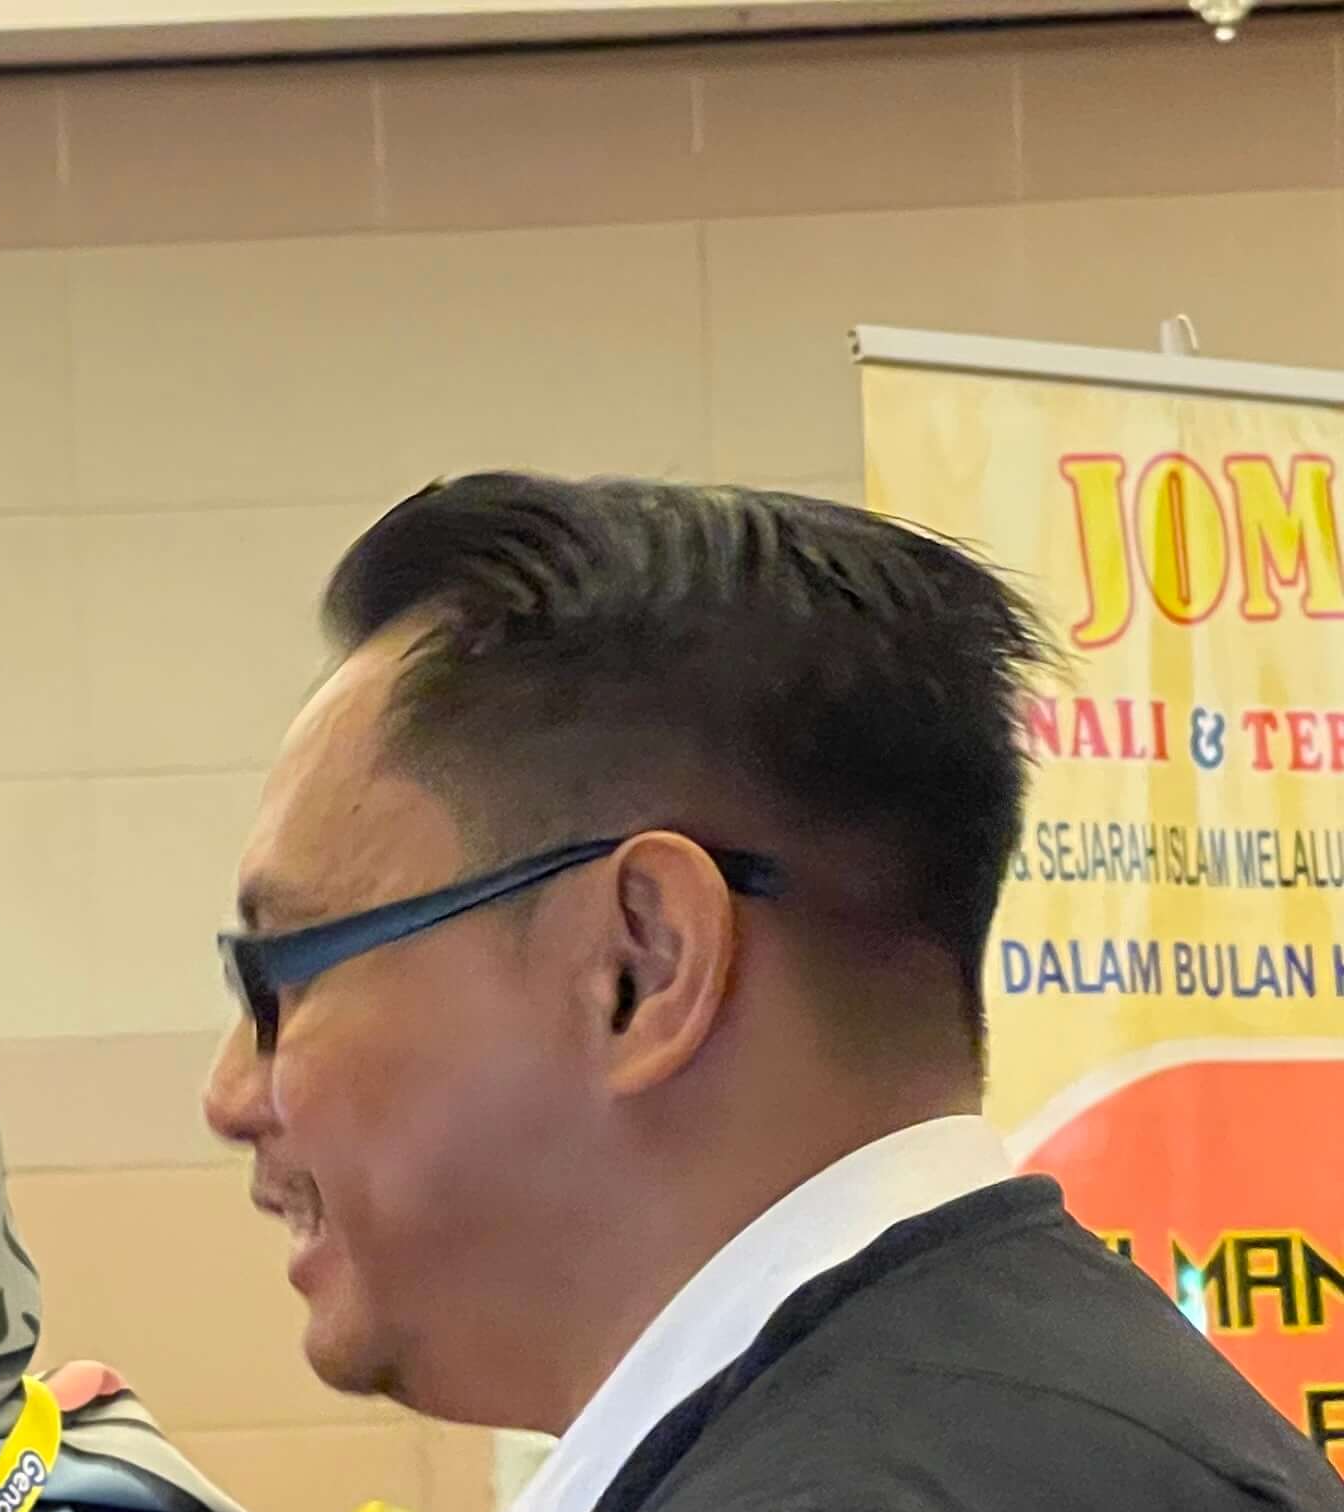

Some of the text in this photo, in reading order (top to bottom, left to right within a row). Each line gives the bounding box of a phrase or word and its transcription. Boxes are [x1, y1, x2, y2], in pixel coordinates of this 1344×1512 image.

[1058, 453, 1344, 648] JOM
[1189, 705, 1226, 770] &
[1036, 821, 1159, 884] SEJARAH
[1162, 824, 1231, 887] ISLAM
[1000, 938, 1162, 995] DALAM
[1173, 942, 1316, 999] BULAN
